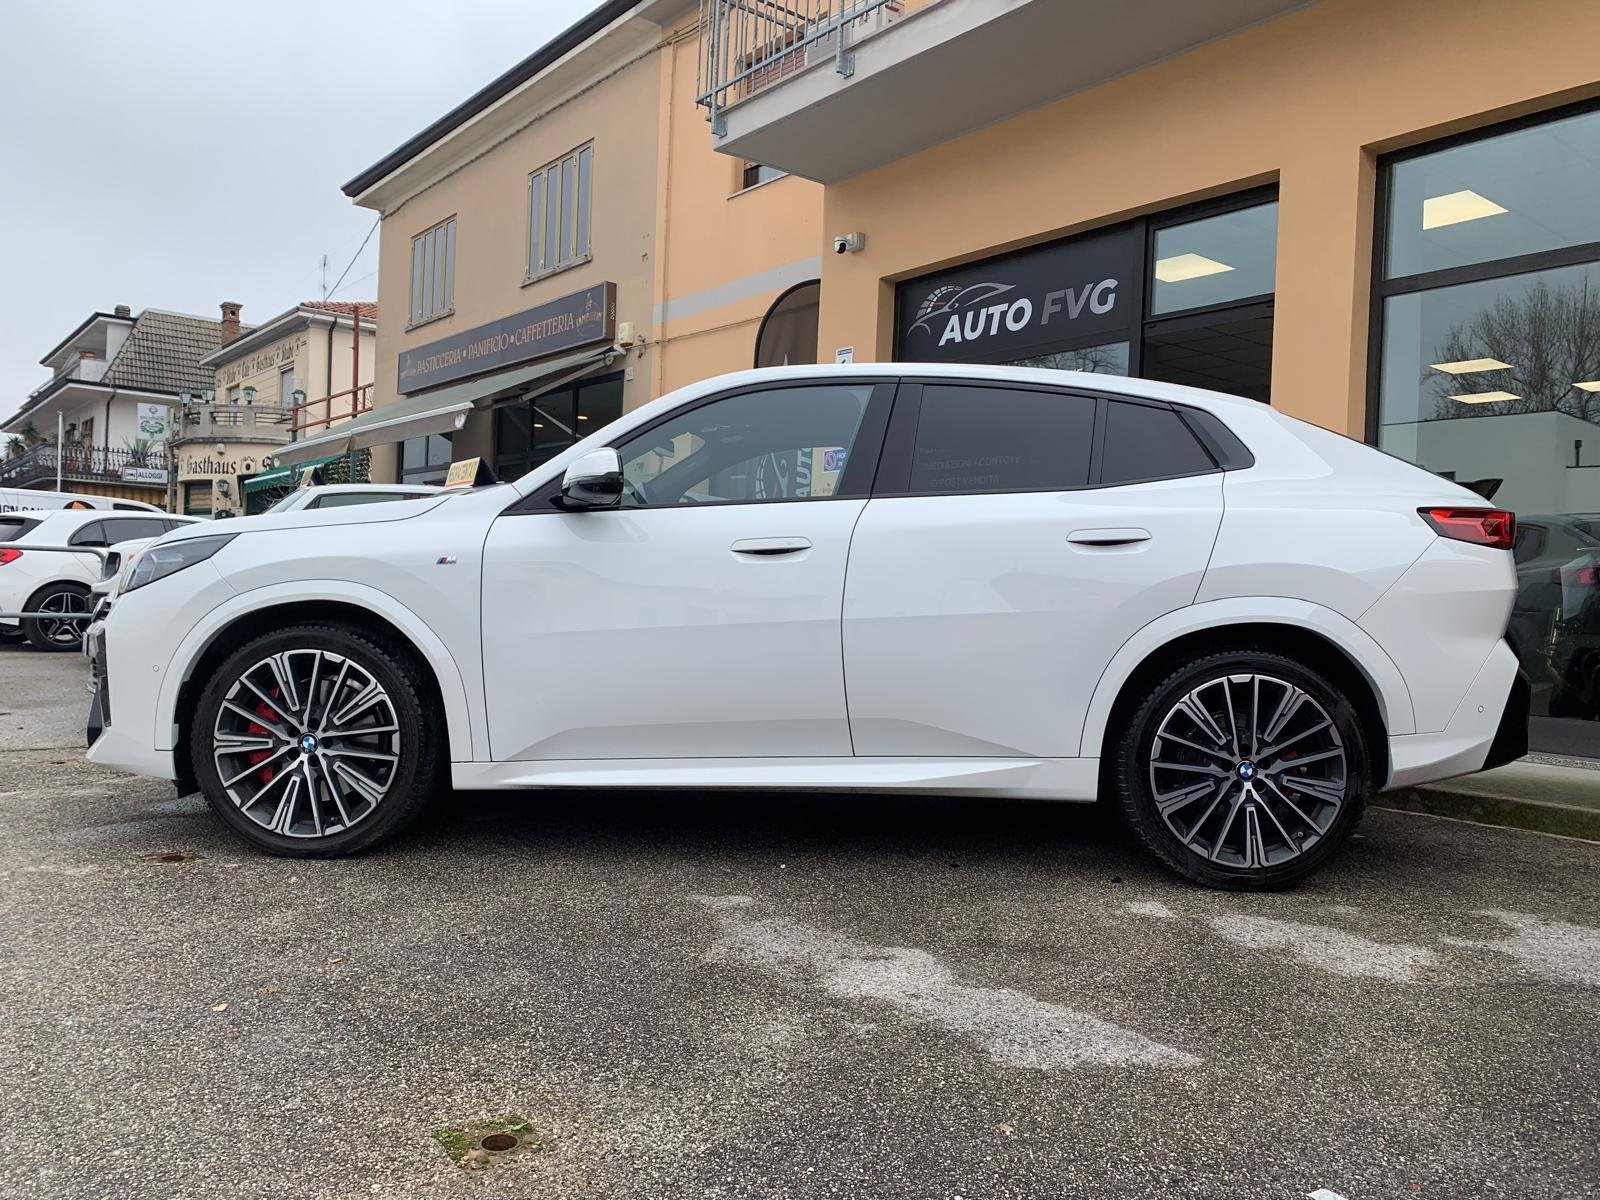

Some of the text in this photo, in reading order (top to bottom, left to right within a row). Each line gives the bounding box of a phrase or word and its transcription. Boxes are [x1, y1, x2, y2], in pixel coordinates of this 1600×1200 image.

[938, 278, 1119, 347] AUTO FVG
[416, 348, 462, 376] PASTICCERIA
[468, 333, 509, 360] PANIFICIO
[515, 312, 574, 346] CAFFETTERIA
[137, 472, 163, 480] ALLOGGI
[187, 456, 237, 475] Gasthaus
